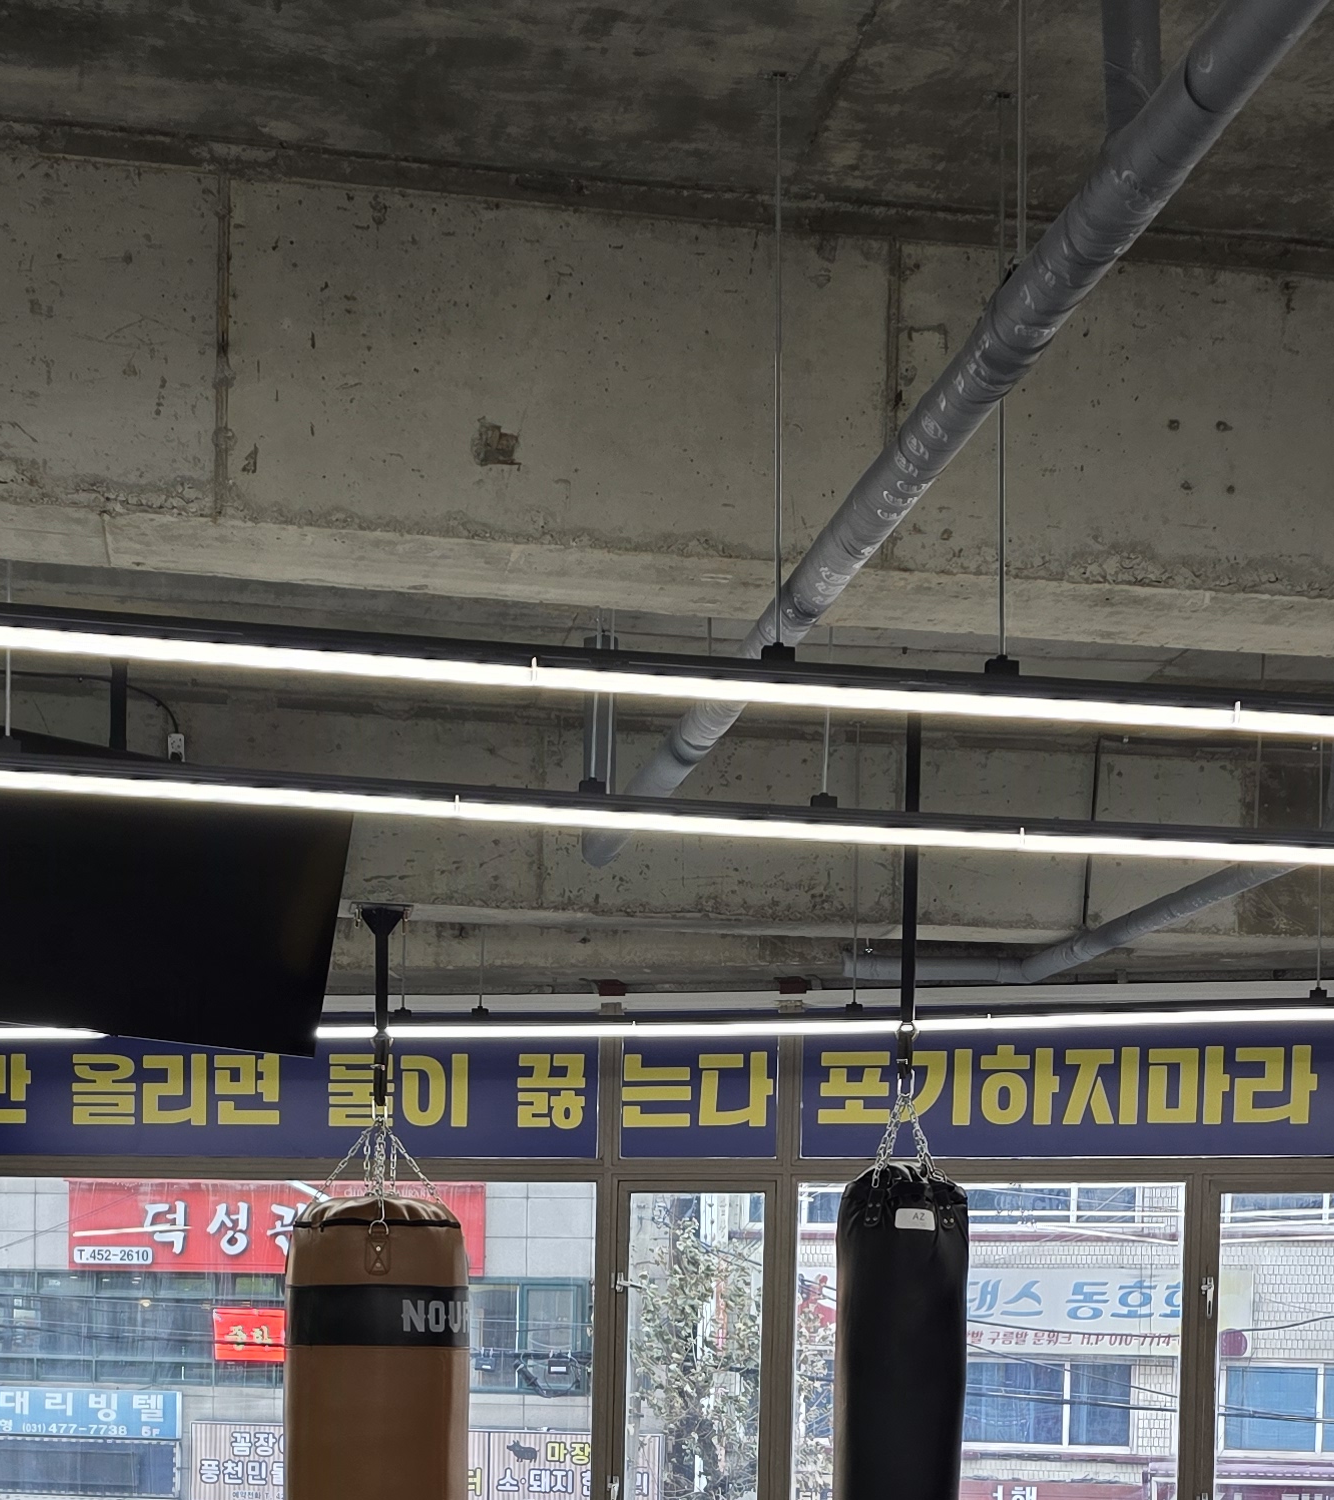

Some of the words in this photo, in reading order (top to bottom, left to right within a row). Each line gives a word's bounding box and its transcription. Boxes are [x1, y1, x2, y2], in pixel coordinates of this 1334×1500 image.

[71, 1053, 280, 1126] 올리면
[817, 1045, 1318, 1127] 포기하지마라
[77, 1249, 149, 1262] T.452-2610
[1108, 1332, 1180, 1347] 010-7714-
[22, 1423, 47, 1434] (031)
[49, 1423, 128, 1436] 477-7738
